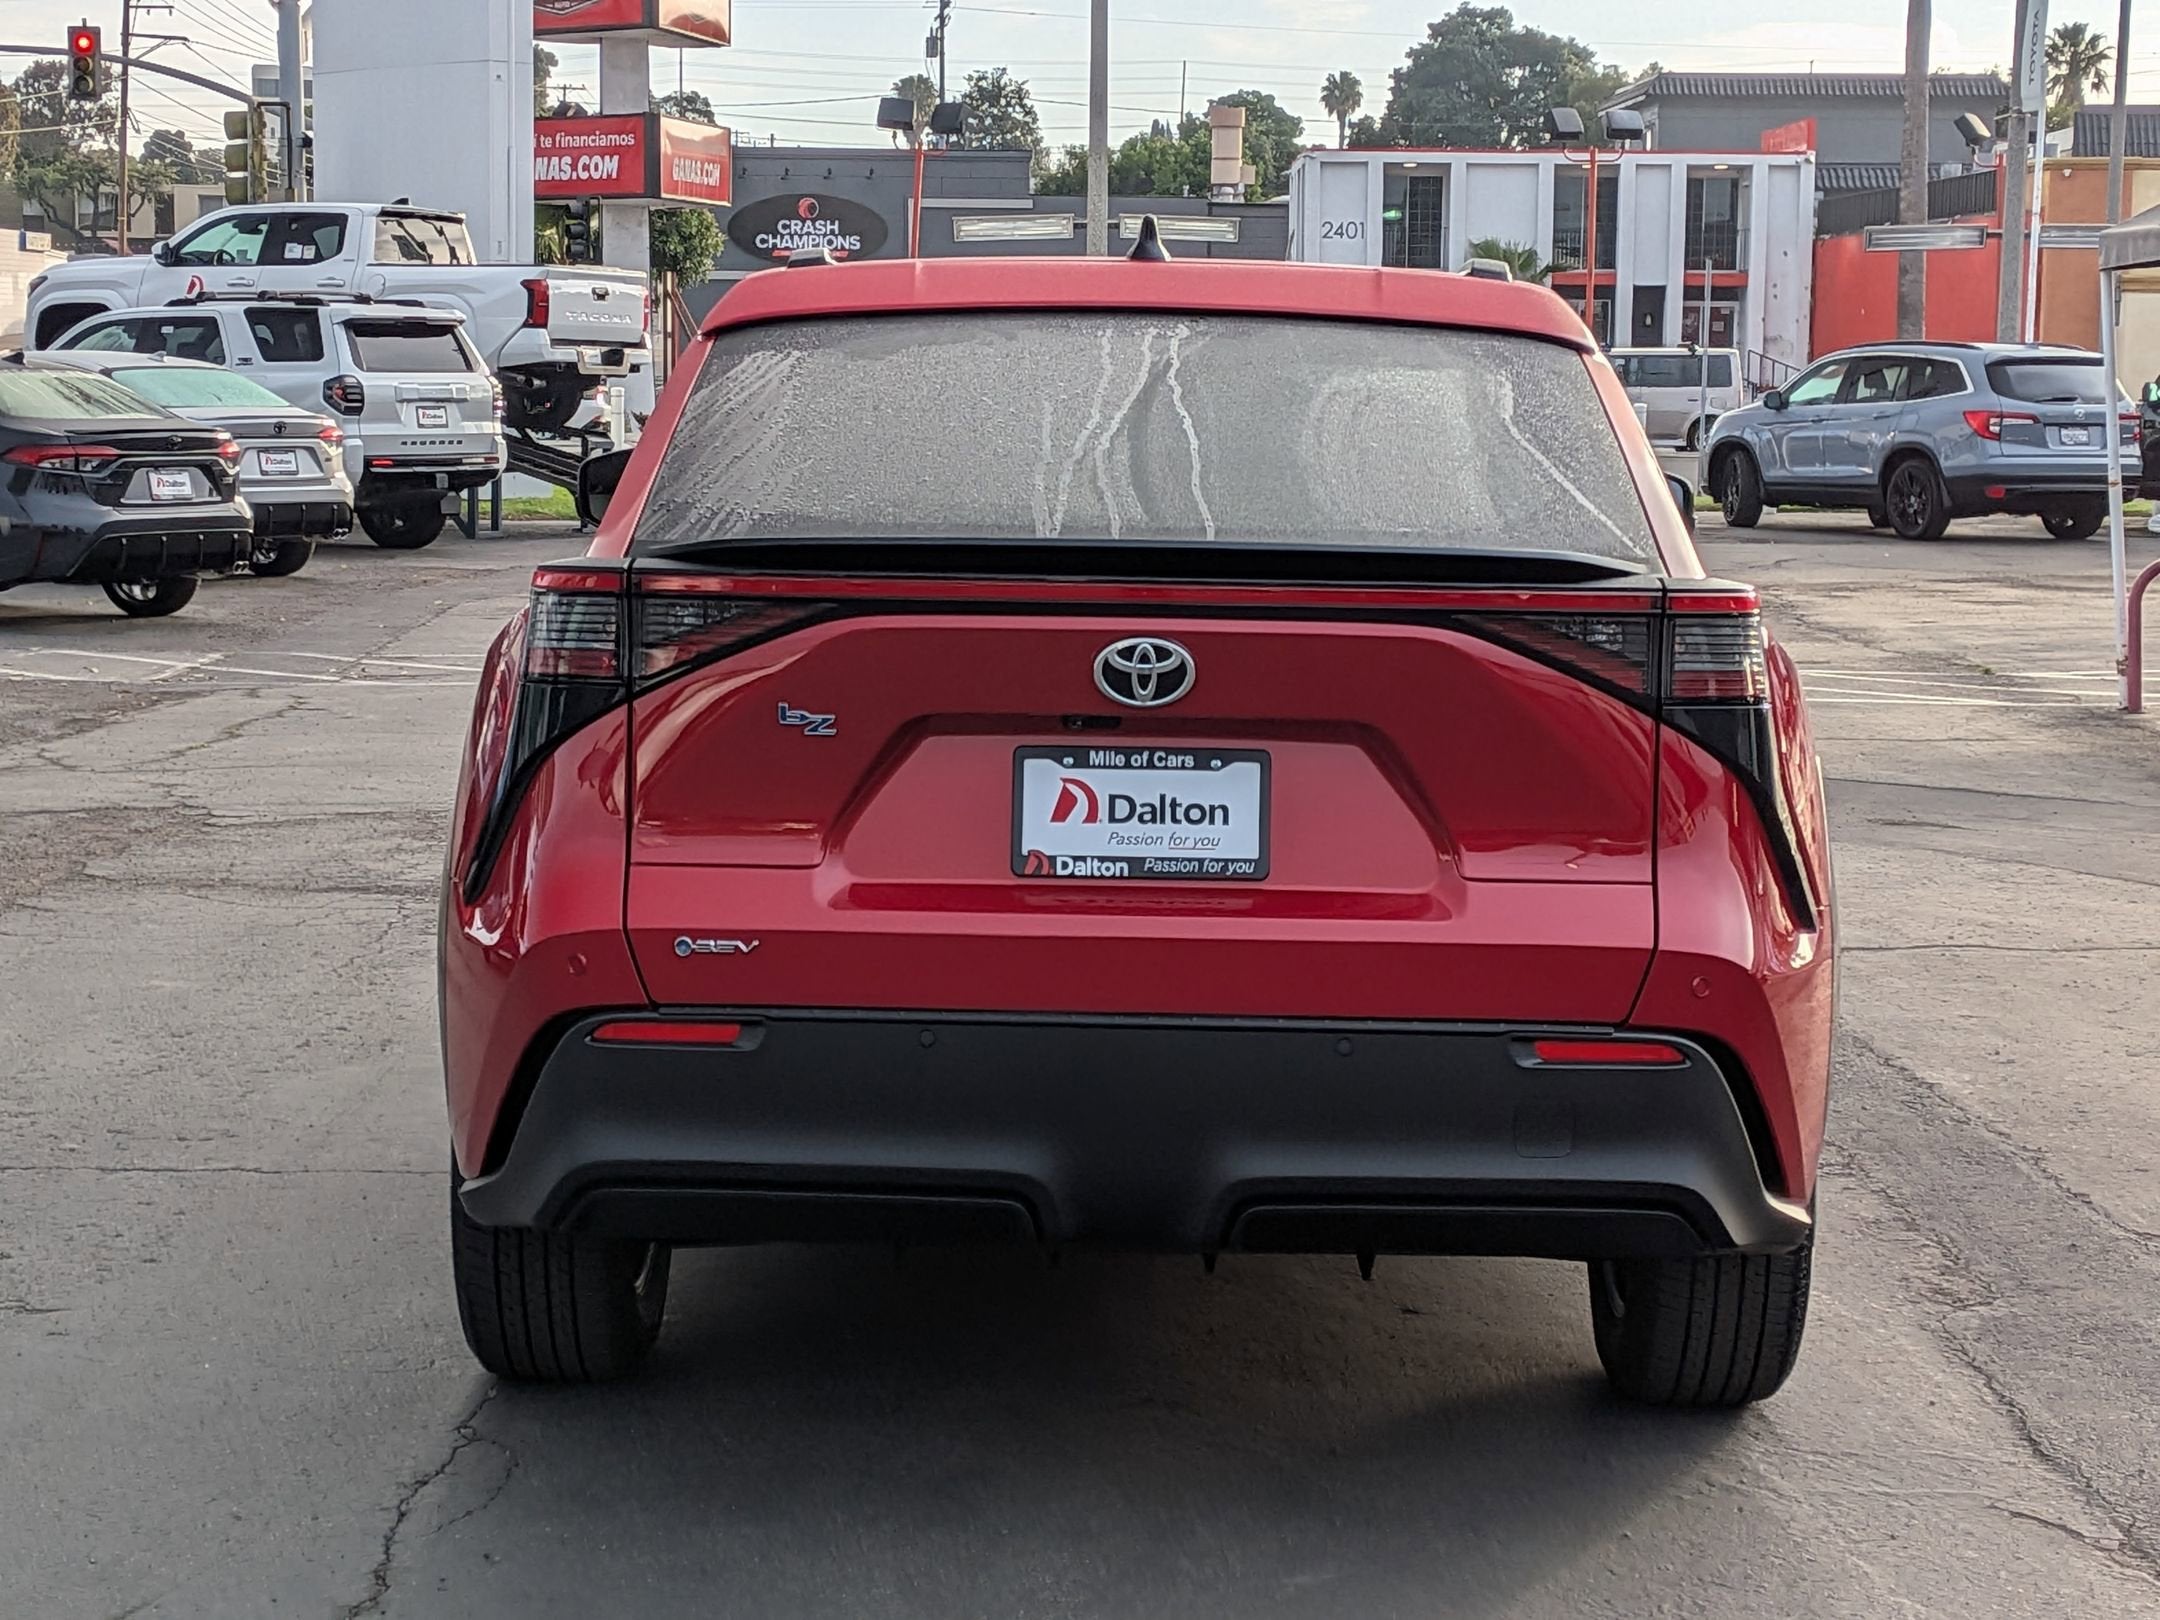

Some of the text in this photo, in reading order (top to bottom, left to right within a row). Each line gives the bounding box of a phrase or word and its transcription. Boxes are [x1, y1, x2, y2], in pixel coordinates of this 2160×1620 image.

[2029, 8, 2040, 86] TOYOTA
[540, 134, 553, 148] te
[555, 131, 635, 148] financiamos
[672, 157, 721, 187] GANAS.COM
[777, 219, 839, 235] CRASH
[1322, 221, 1364, 239] 2401
[755, 233, 861, 250] CHAMPIONS
[565, 311, 632, 324] TACOMA
[1089, 750, 1195, 768] Mile of Cars
[1107, 793, 1230, 826] Dalton
[1107, 831, 1221, 849] Passion for you
[1056, 856, 1255, 876] Dalton Passion for you
